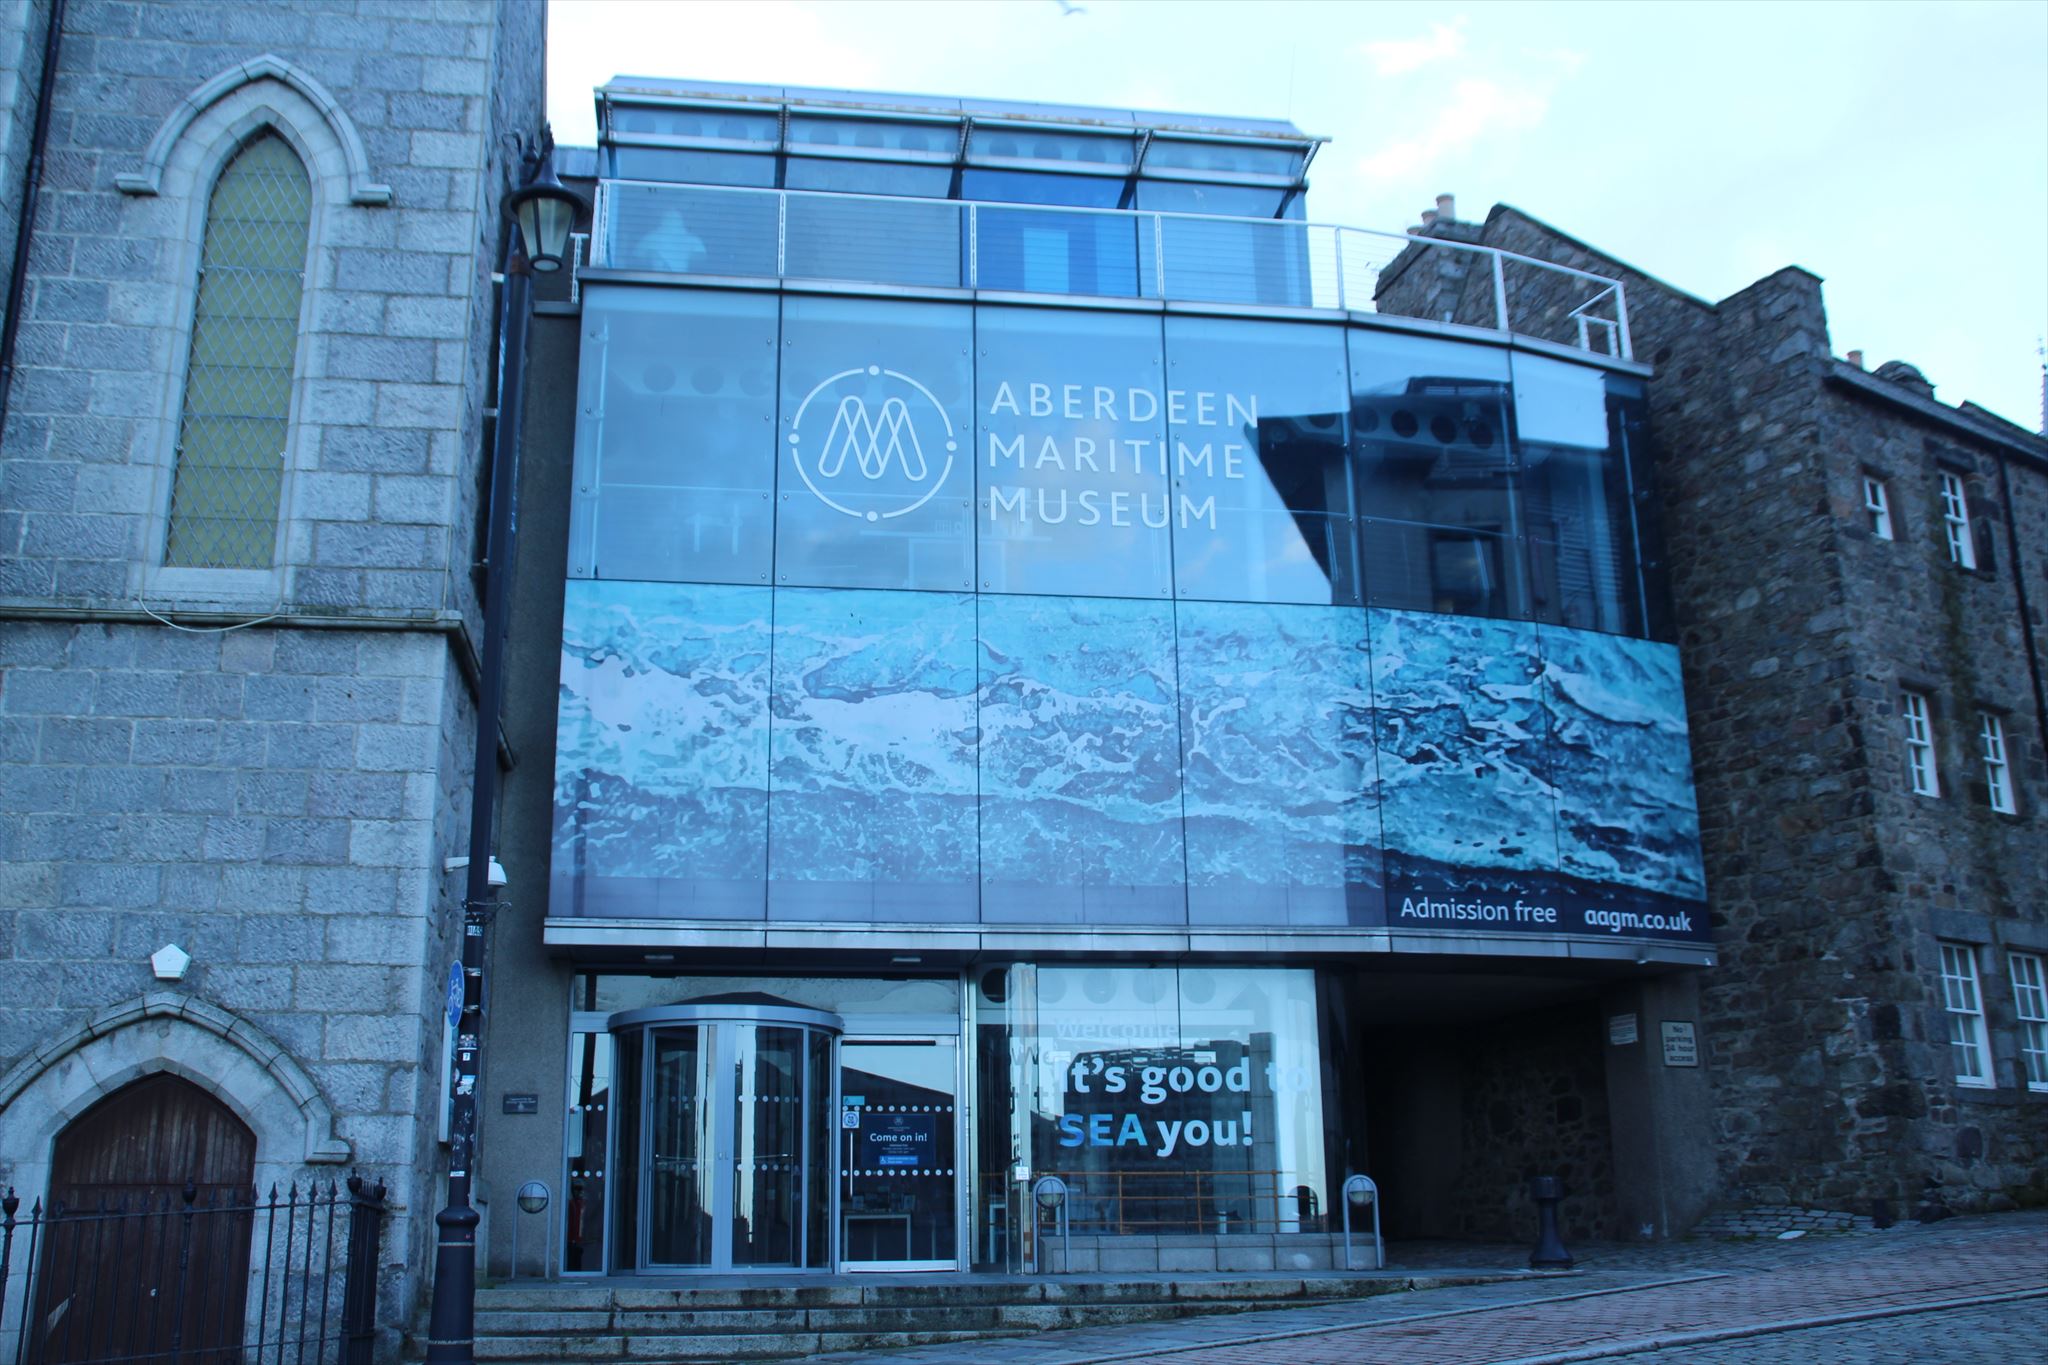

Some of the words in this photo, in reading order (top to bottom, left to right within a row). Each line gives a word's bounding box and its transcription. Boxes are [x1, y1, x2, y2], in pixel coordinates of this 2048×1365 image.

[990, 381, 1258, 429] ABERDEEN
[989, 433, 1245, 479] MARITIME
[989, 486, 1217, 530] MUSEUM
[1400, 897, 1509, 921] Admission
[1514, 900, 1557, 923] free
[1584, 909, 1693, 932] aagm.co.uk
[1140, 1056, 1250, 1105] good
[870, 1132, 898, 1142] Come
[900, 1134, 912, 1142] on
[915, 1131, 928, 1142] in!
[1059, 1113, 1148, 1147] SEA
[1156, 1111, 1254, 1158] you!
